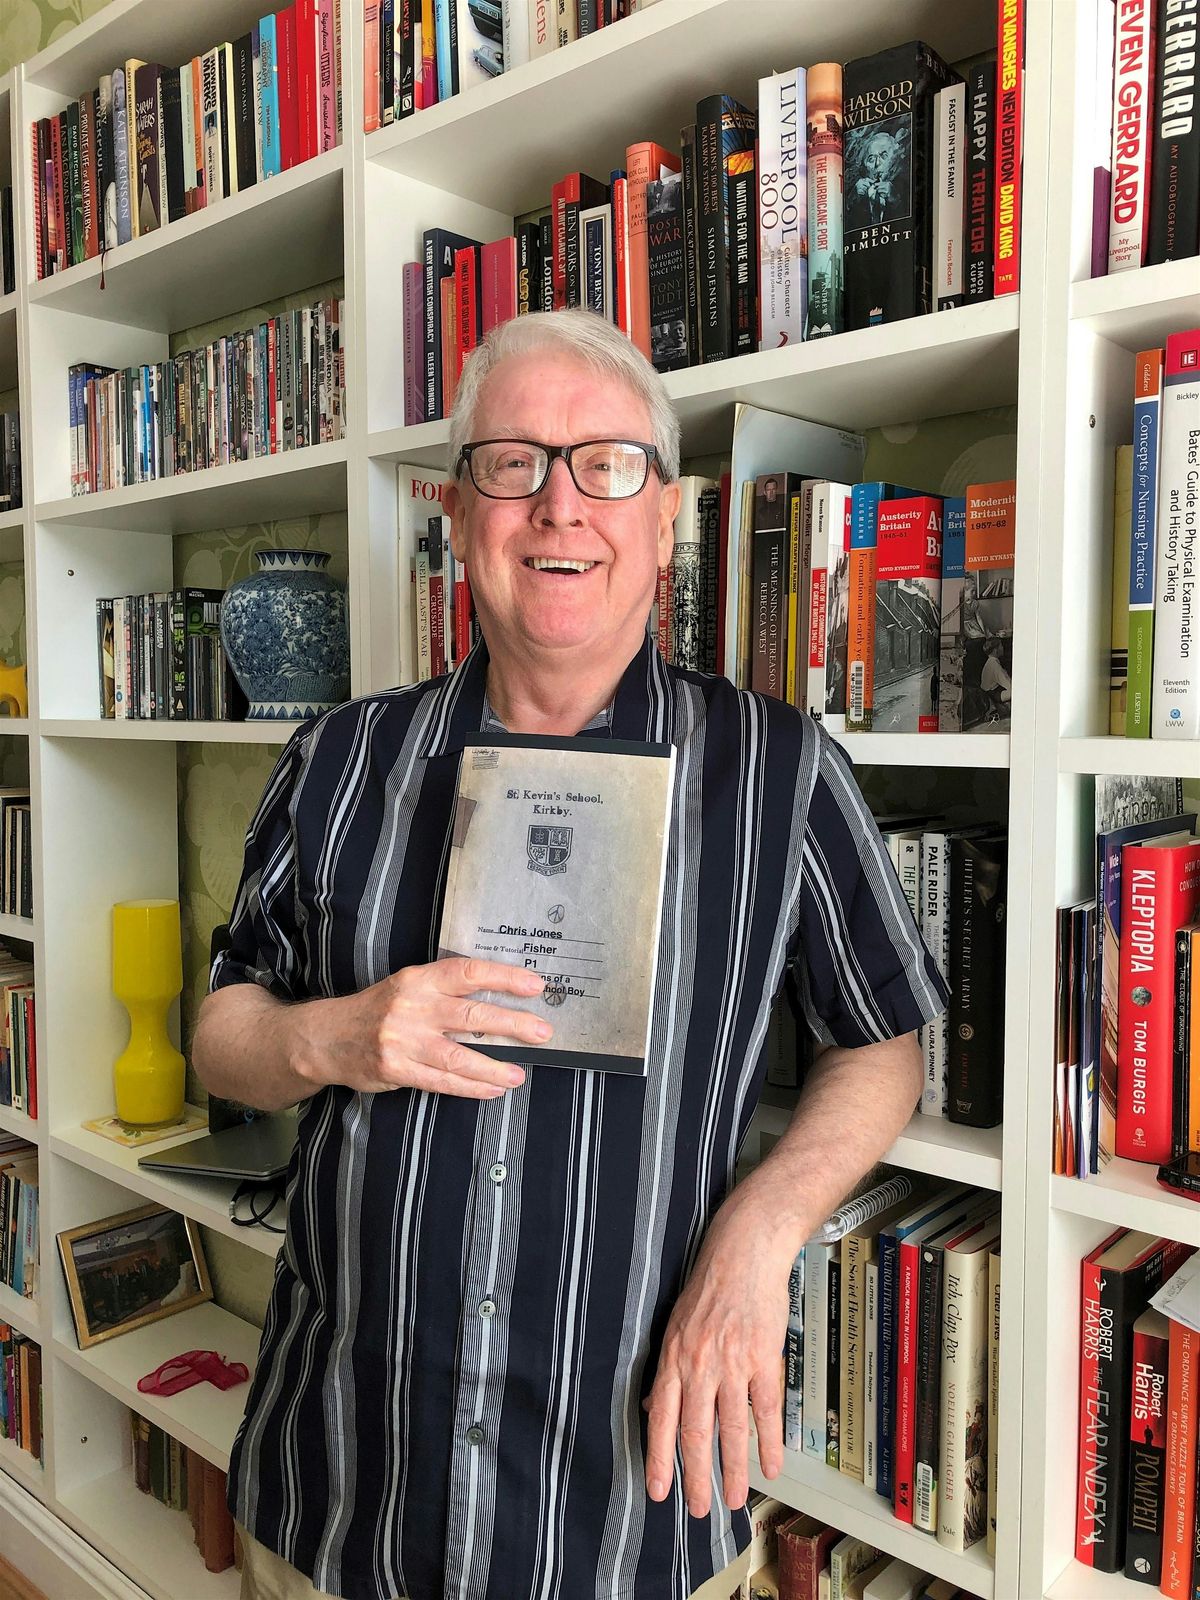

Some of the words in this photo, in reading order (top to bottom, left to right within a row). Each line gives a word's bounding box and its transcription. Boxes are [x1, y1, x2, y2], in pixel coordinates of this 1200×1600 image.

[1002, 20, 1017, 91] VANISHES
[203, 59, 212, 112] MARKS
[844, 80, 913, 115] HAROLD
[844, 95, 913, 129] WILSON
[1001, 91, 1015, 125] NEW
[81, 113, 89, 149] PRIVATE
[117, 110, 126, 143] KATE
[948, 134, 956, 146] IN
[972, 92, 987, 162] HAPPY
[780, 80, 798, 243] LIVERPOOL
[816, 156, 827, 175] THE
[948, 147, 956, 165] THE
[1000, 126, 1015, 184] EDITION
[1114, 80, 1143, 225] GERRARD
[117, 149, 129, 219] ATKINSON
[947, 166, 956, 199] FAMILY
[736, 180, 747, 221] WAITING
[760, 173, 779, 230] 800
[816, 176, 827, 227] HURRICANE
[970, 167, 986, 255] TRAITOR
[999, 184, 1015, 225] DAVID
[1167, 165, 1180, 253] AUTOBIOGRAPHY
[567, 207, 576, 233] TEN
[736, 221, 747, 242] FOR
[861, 224, 891, 239] BEN
[567, 236, 576, 271] YEARS
[650, 227, 682, 247] WAR
[706, 227, 715, 270] SIMON
[737, 242, 748, 261] THE
[817, 228, 828, 251] PORT
[844, 230, 913, 255] PIMLOTT
[998, 227, 1013, 260] KING
[1118, 238, 1129, 247] My
[594, 245, 602, 273] TONY
[737, 262, 748, 284] MAN
[1115, 254, 1131, 263] Story
[594, 279, 602, 310] BENN
[998, 274, 1012, 282] TATE
[708, 274, 717, 327] JENKINS
[427, 351, 435, 376] EILEEN
[427, 378, 436, 416] TURNBULL
[1176, 393, 1199, 401] Bickley
[1138, 414, 1153, 472] Concepts
[1138, 473, 1150, 488] for
[1186, 470, 1199, 509] Guide
[880, 511, 922, 522] Austerity
[970, 509, 1007, 519] Britain
[1135, 490, 1150, 542] Nursing
[1170, 489, 1179, 512] and
[880, 523, 911, 531] Britain
[970, 520, 1007, 530] 1957-62
[1185, 510, 1196, 525] to
[1166, 515, 1181, 562] History
[1183, 529, 1197, 580] Physical
[771, 544, 779, 567] THE
[803, 543, 811, 569] Morgan
[968, 555, 989, 563] DAVID
[1136, 542, 1149, 589] Practice
[857, 553, 867, 600] Formation
[1163, 564, 1178, 603] Taking
[770, 569, 778, 621] MEANING
[420, 598, 428, 632] LAST'S
[430, 595, 438, 639] CRUSADE
[857, 605, 865, 622] and
[1180, 582, 1195, 659] Examination
[769, 624, 776, 639] OF
[857, 625, 865, 646] early
[768, 641, 777, 691] TREASON
[1163, 679, 1190, 687] Eleventh
[1165, 687, 1188, 695] Edition
[523, 790, 561, 801] Kevin's
[566, 792, 604, 805] School,
[533, 805, 573, 817] Kirkby.
[904, 865, 916, 886] THE
[928, 846, 938, 876] PALE
[927, 877, 937, 918] RIDER
[477, 926, 494, 934] Name
[499, 925, 527, 936] Chris
[530, 928, 563, 939] Jones
[1130, 869, 1156, 973] KLEPTOPIA
[523, 943, 557, 954] Fisher
[962, 919, 972, 971] SECRET
[524, 959, 537, 968] P1
[554, 975, 563, 983] of
[567, 987, 585, 997] Boy
[961, 976, 971, 1010] ARMY
[1133, 1021, 1147, 1052] TOM
[1133, 1057, 1147, 1116] BURGIS
[848, 1238, 859, 1261] The
[848, 1263, 859, 1297] Soviet
[883, 1244, 894, 1342] NEUROLITERATURE
[948, 1274, 962, 1299] Itch,
[848, 1299, 858, 1340] Health
[944, 1303, 962, 1334] Clap,
[1083, 1297, 1100, 1362] HARRIS
[1099, 1306, 1113, 1361] ROBERT
[943, 1338, 959, 1363] Pox
[1182, 1333, 1191, 1349] THE
[788, 1352, 797, 1385] Coetzee
[847, 1344, 857, 1386] Service
[1093, 1366, 1103, 1386] THE
[1181, 1351, 1190, 1401] ORDNANCE
[947, 1383, 956, 1427] NOELLE
[1134, 1362, 1153, 1420] Harris
[1151, 1373, 1165, 1418] Robert
[1086, 1384, 1110, 1448] FEAR
[1172, 1411, 1178, 1422] BY
[1179, 1403, 1189, 1435] SURVEY
[1170, 1424, 1178, 1466] ORDNANCE
[1178, 1436, 1188, 1469] PUZZLE
[944, 1430, 955, 1502] GALLAGHER
[1178, 1471, 1187, 1494] TOUR
[1083, 1450, 1108, 1528] INDEX
[1132, 1450, 1160, 1533] POMPEII
[1177, 1496, 1186, 1510] OF
[942, 1524, 956, 1537] Yale
[1176, 1511, 1185, 1544] BRITAIN
